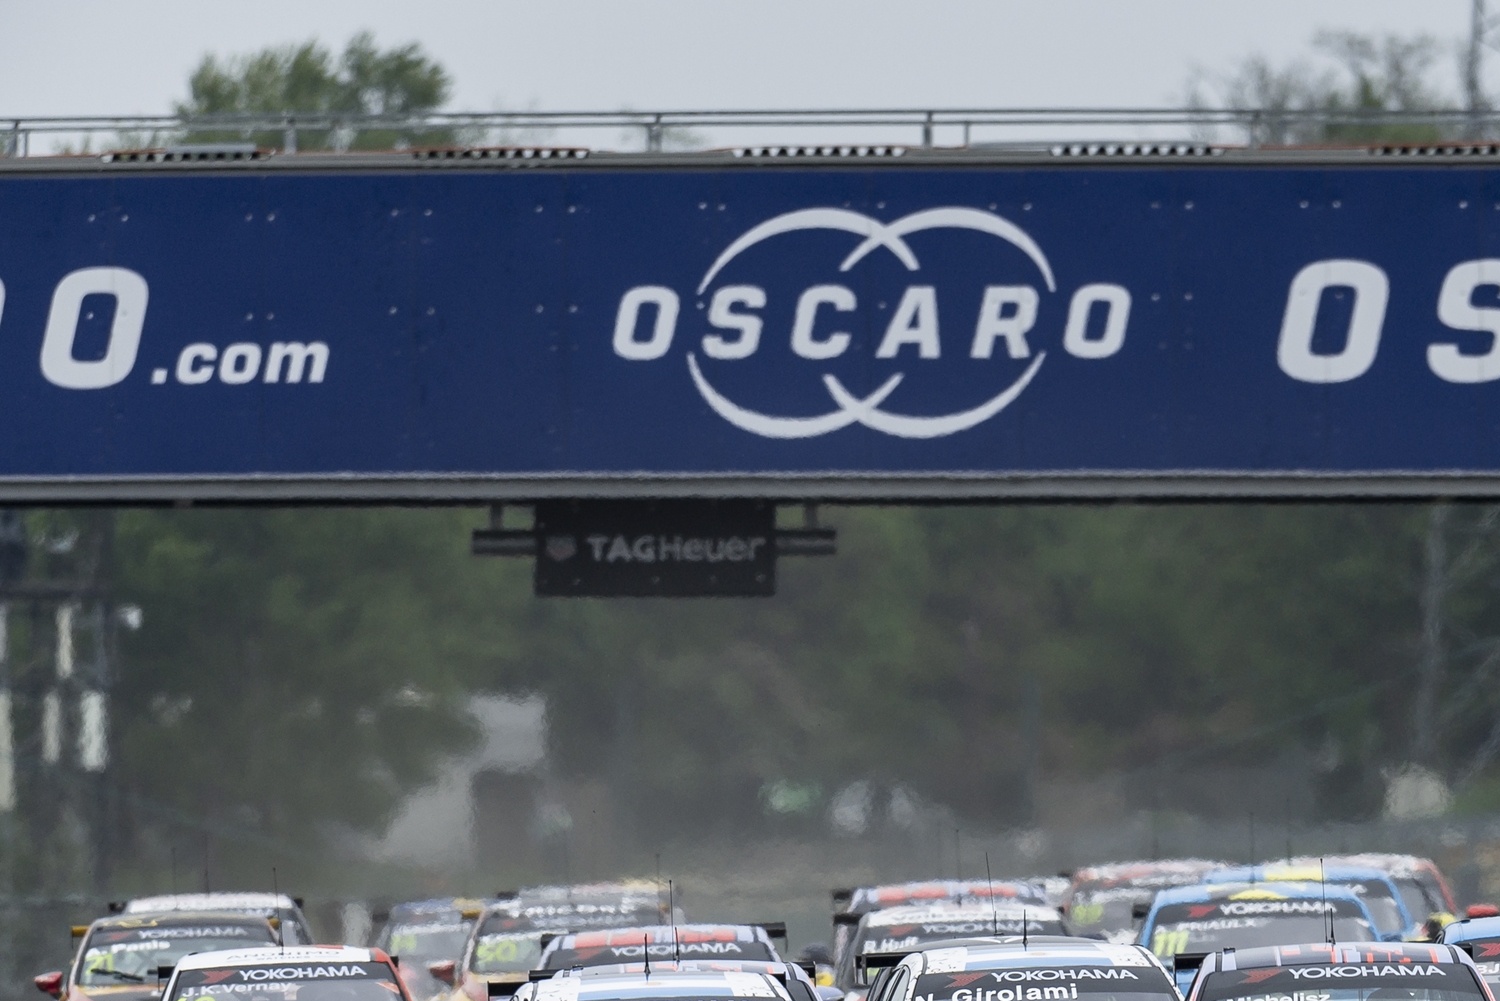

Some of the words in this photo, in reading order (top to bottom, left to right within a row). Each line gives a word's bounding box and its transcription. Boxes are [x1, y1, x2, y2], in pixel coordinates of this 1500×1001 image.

[0, 266, 330, 390] O.com
[612, 283, 1132, 361] OSCARO
[138, 926, 248, 940] YOKOHAMA
[611, 942, 741, 956] YOKOHAMA
[1155, 930, 1189, 955] 111
[239, 965, 368, 981] YOKOHAMA
[991, 969, 1139, 983] YOKOHAMA
[1289, 965, 1447, 980] YOKOHAMA
